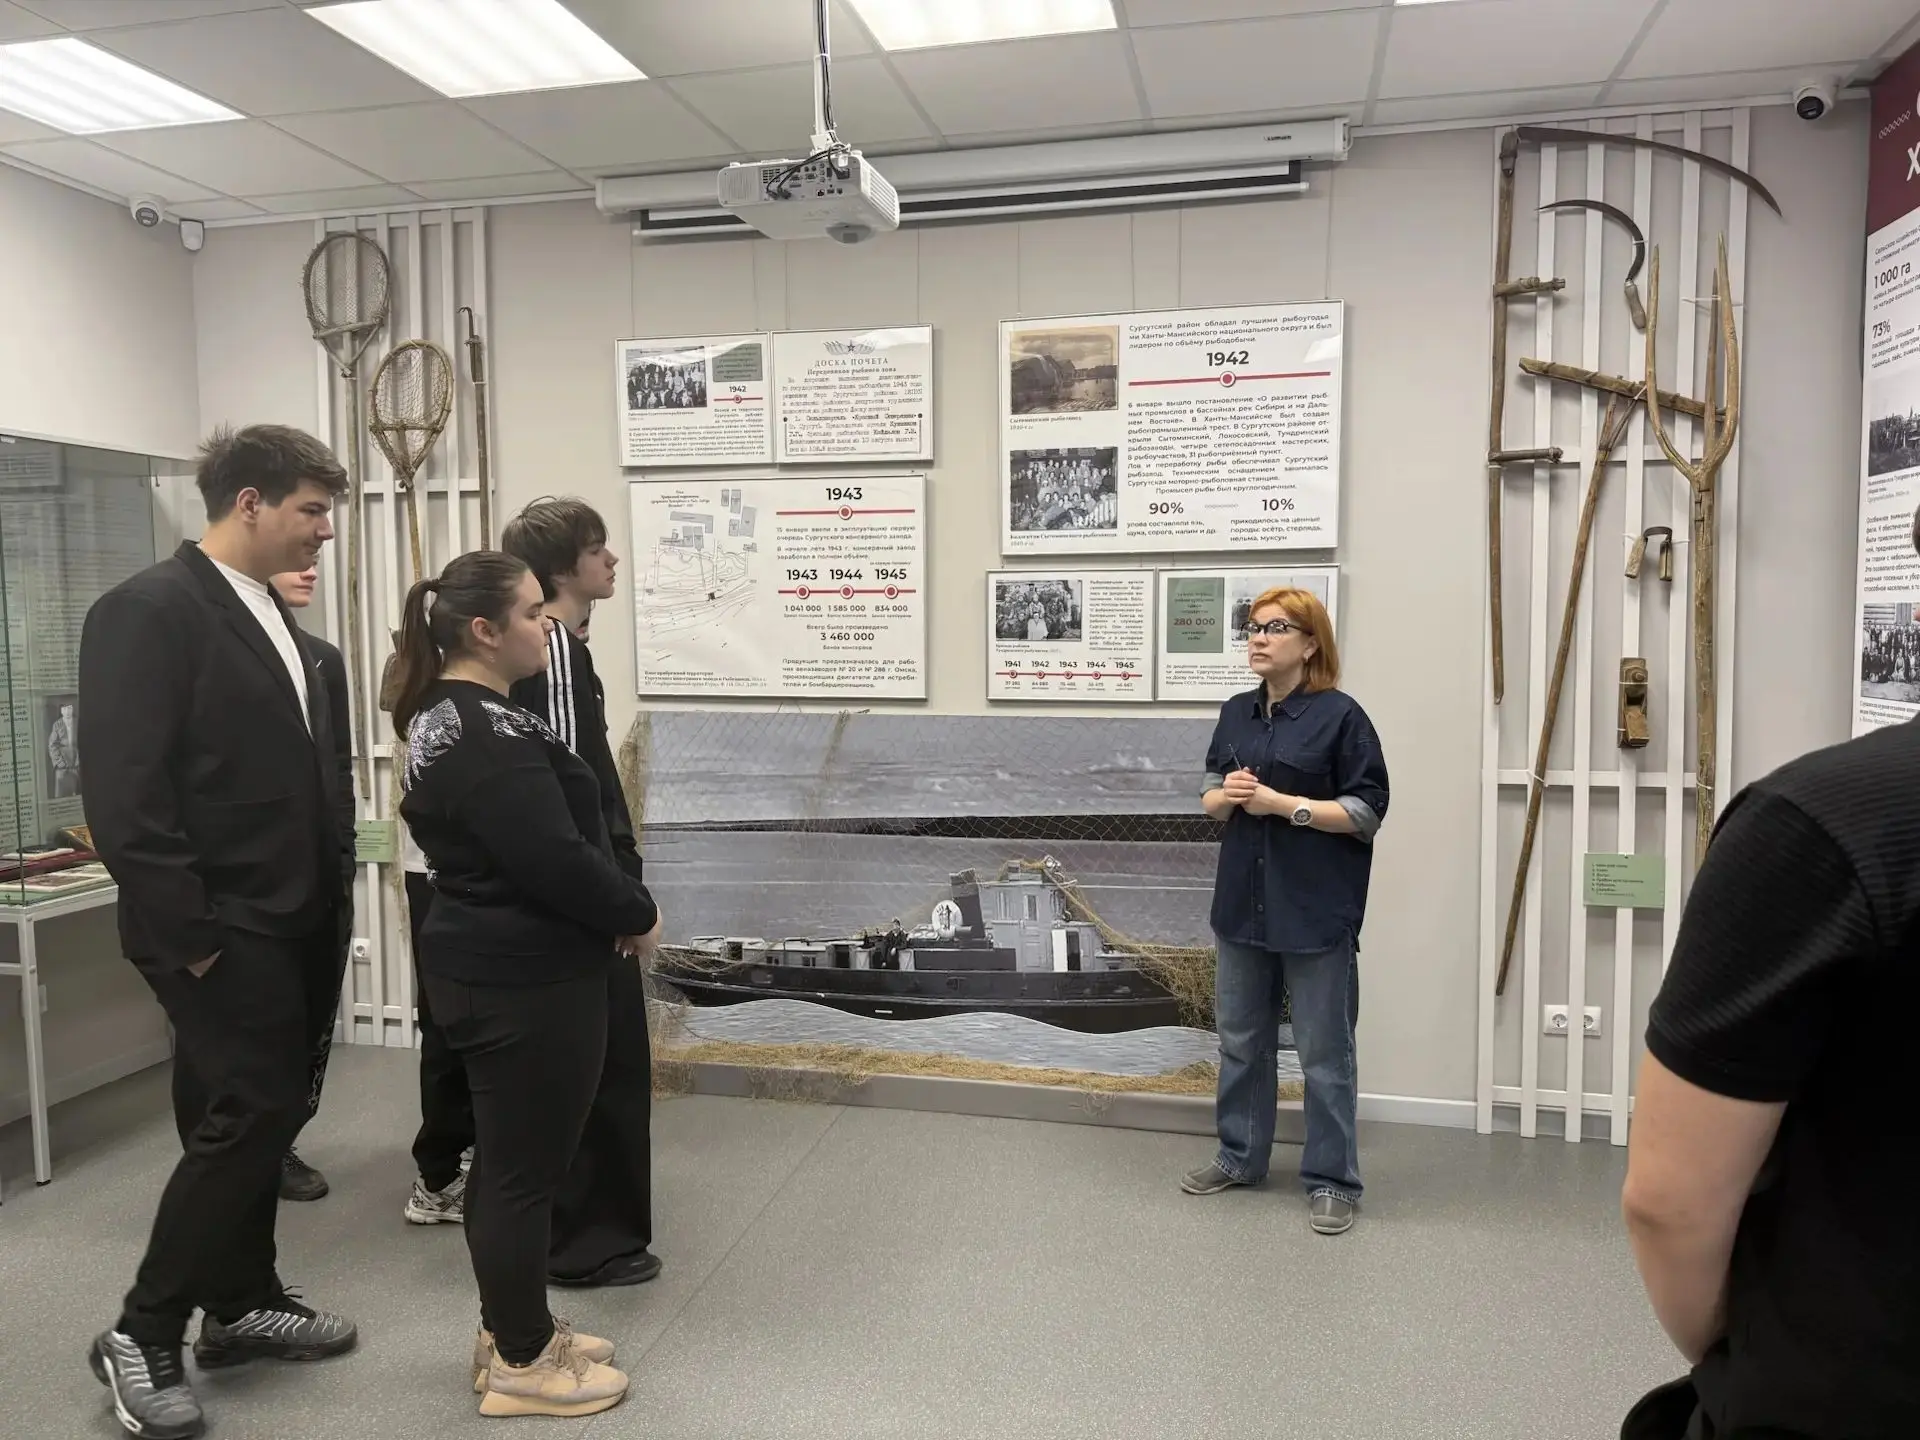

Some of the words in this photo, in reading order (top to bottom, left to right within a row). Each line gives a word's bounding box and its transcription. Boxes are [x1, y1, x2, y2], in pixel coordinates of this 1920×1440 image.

[1874, 276, 1878, 288] 1
[1880, 266, 1898, 286] 000
[1901, 262, 1910, 276] га
[1129, 323, 1172, 332] Сургутский
[1142, 330, 1218, 340] Ханты-Мансийского
[1220, 326, 1279, 335] национального
[1281, 324, 1307, 332] округа
[1872, 319, 1890, 338] 73%
[1129, 342, 1162, 350] лидером
[1175, 339, 1203, 347] объёму
[814, 360, 846, 368] ДОСКА
[851, 358, 888, 366] ПОЧЕТА
[1206, 350, 1249, 366] 1942
[1145, 409, 1187, 417] промыслов
[1204, 414, 1272, 422] Ханты-Мансийске
[1128, 426, 1207, 434] рыбопромышленный
[1241, 422, 1285, 430] Сургутском
[1158, 434, 1211, 442] Сытоминский,
[1218, 432, 1270, 440] Локосовский,
[1278, 428, 1329, 437] Тундринский
[1285, 455, 1328, 464] Сургутский
[1128, 480, 1166, 488] Сургутская
[1168, 477, 1246, 486] моторно-рыболовная
[826, 487, 862, 500] 1943
[1149, 502, 1184, 514] 90%
[1262, 498, 1295, 511] 10%
[786, 569, 818, 580] 1943
[830, 569, 863, 580] 1944
[874, 568, 907, 580] 1945
